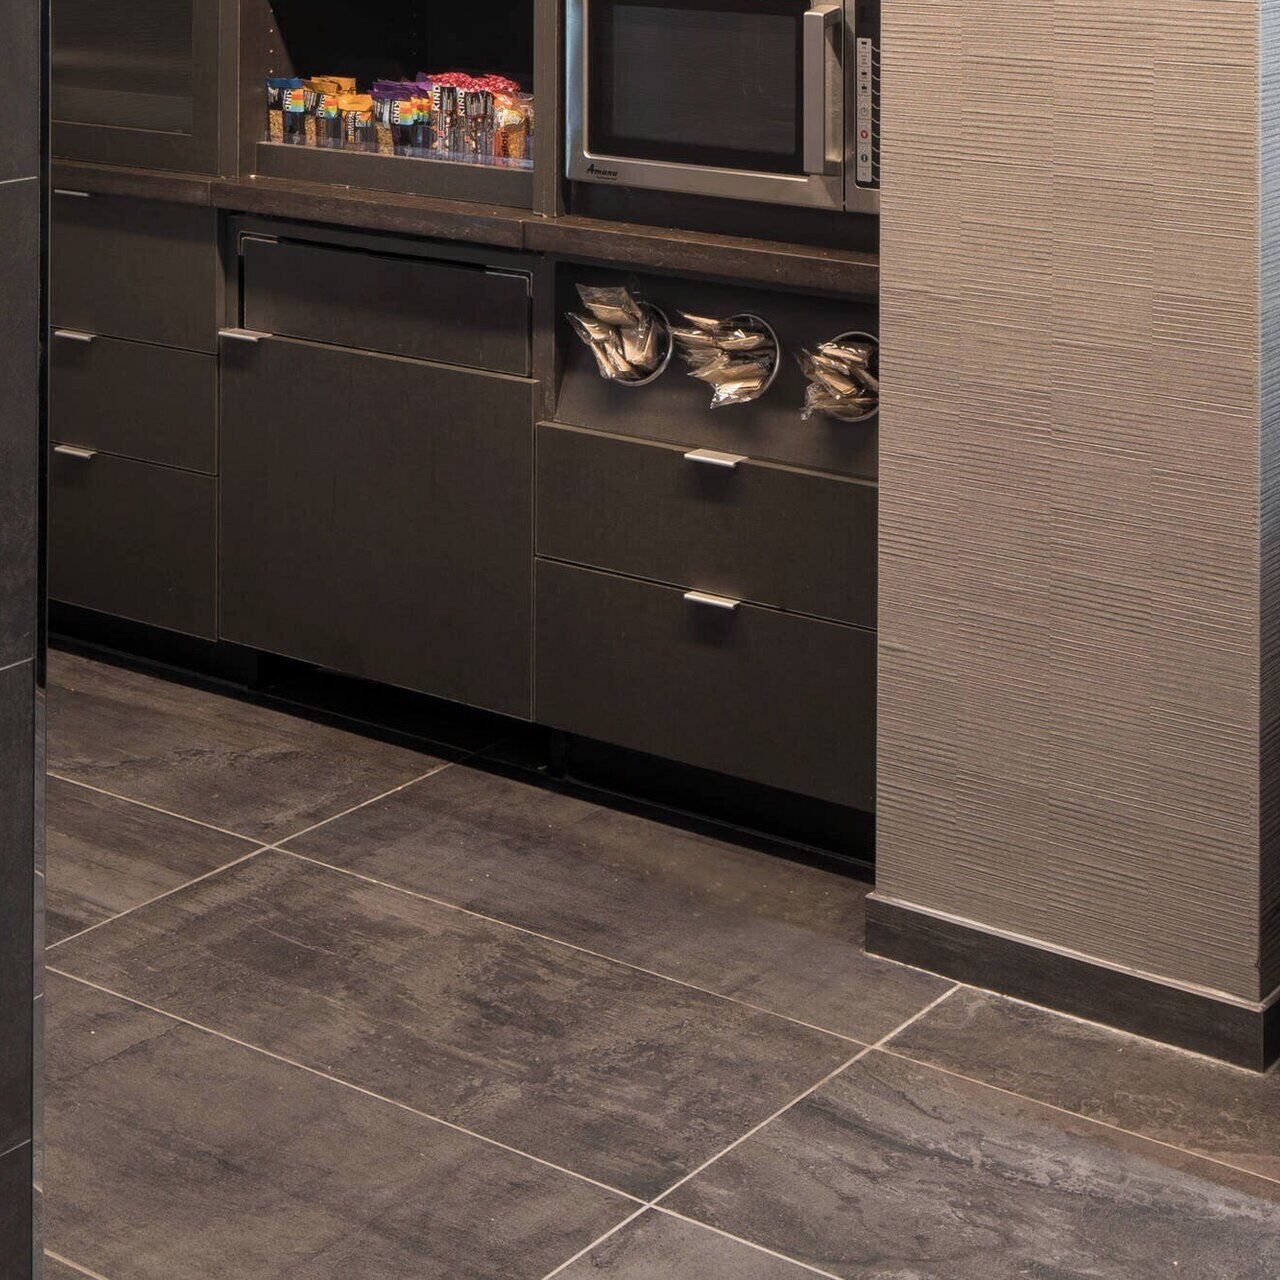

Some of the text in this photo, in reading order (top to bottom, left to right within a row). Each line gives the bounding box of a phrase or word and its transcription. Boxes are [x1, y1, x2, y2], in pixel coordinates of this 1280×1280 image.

[432, 86, 440, 111] KIND
[457, 90, 465, 116] KIND
[586, 163, 618, 176] Amana
